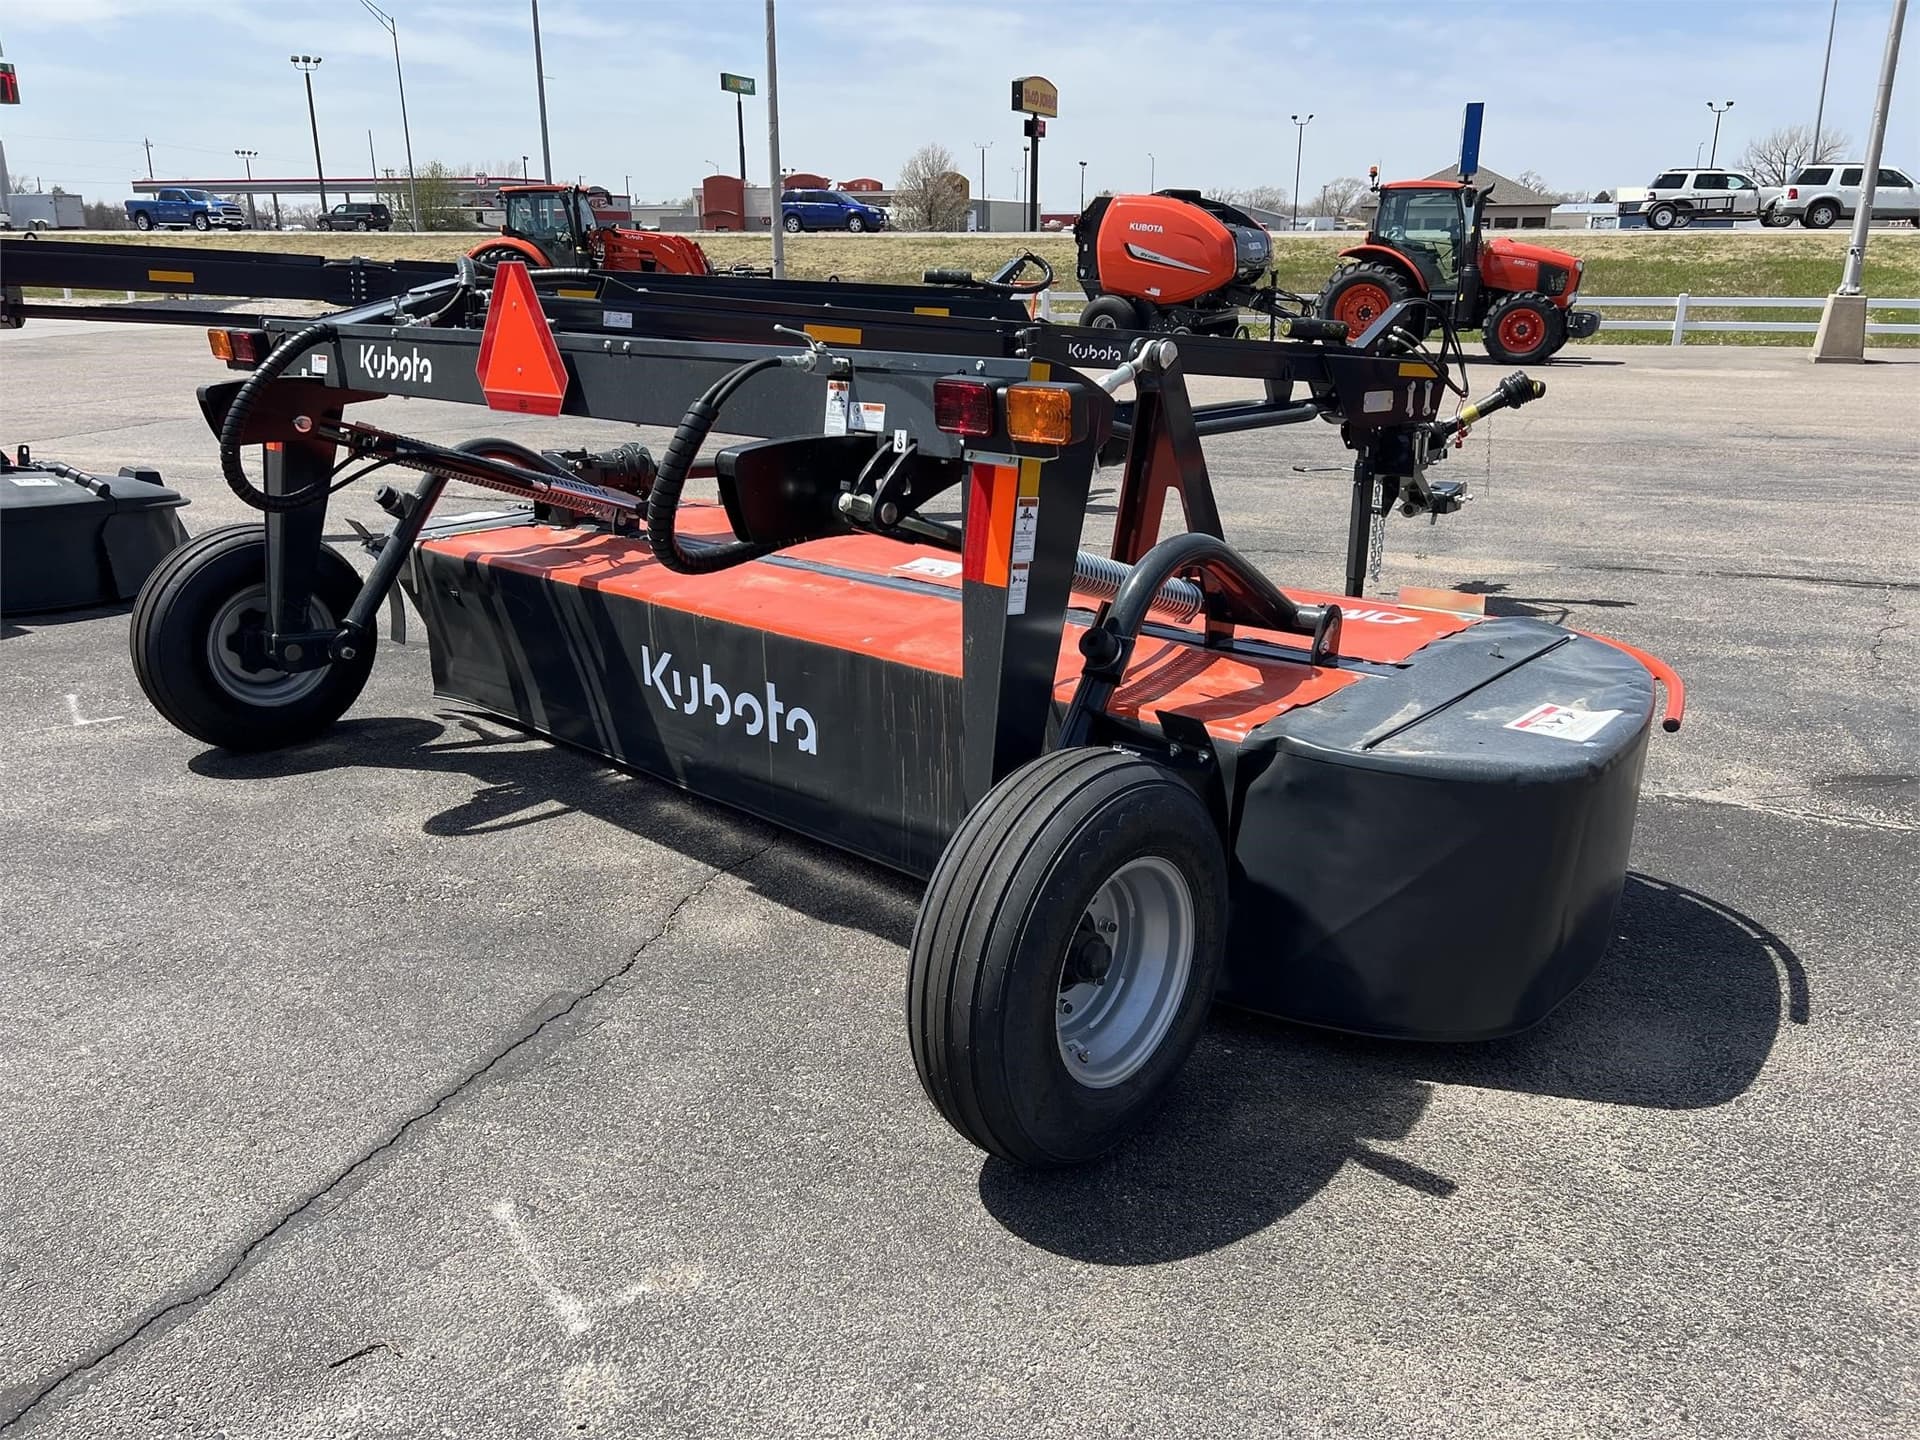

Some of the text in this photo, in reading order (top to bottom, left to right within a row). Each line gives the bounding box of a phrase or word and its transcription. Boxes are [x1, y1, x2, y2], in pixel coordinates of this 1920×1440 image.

[1129, 222, 1164, 233] KUBOTA
[360, 344, 432, 383] Kubota
[1068, 343, 1121, 361] Kubota
[641, 645, 817, 755] Kubota
